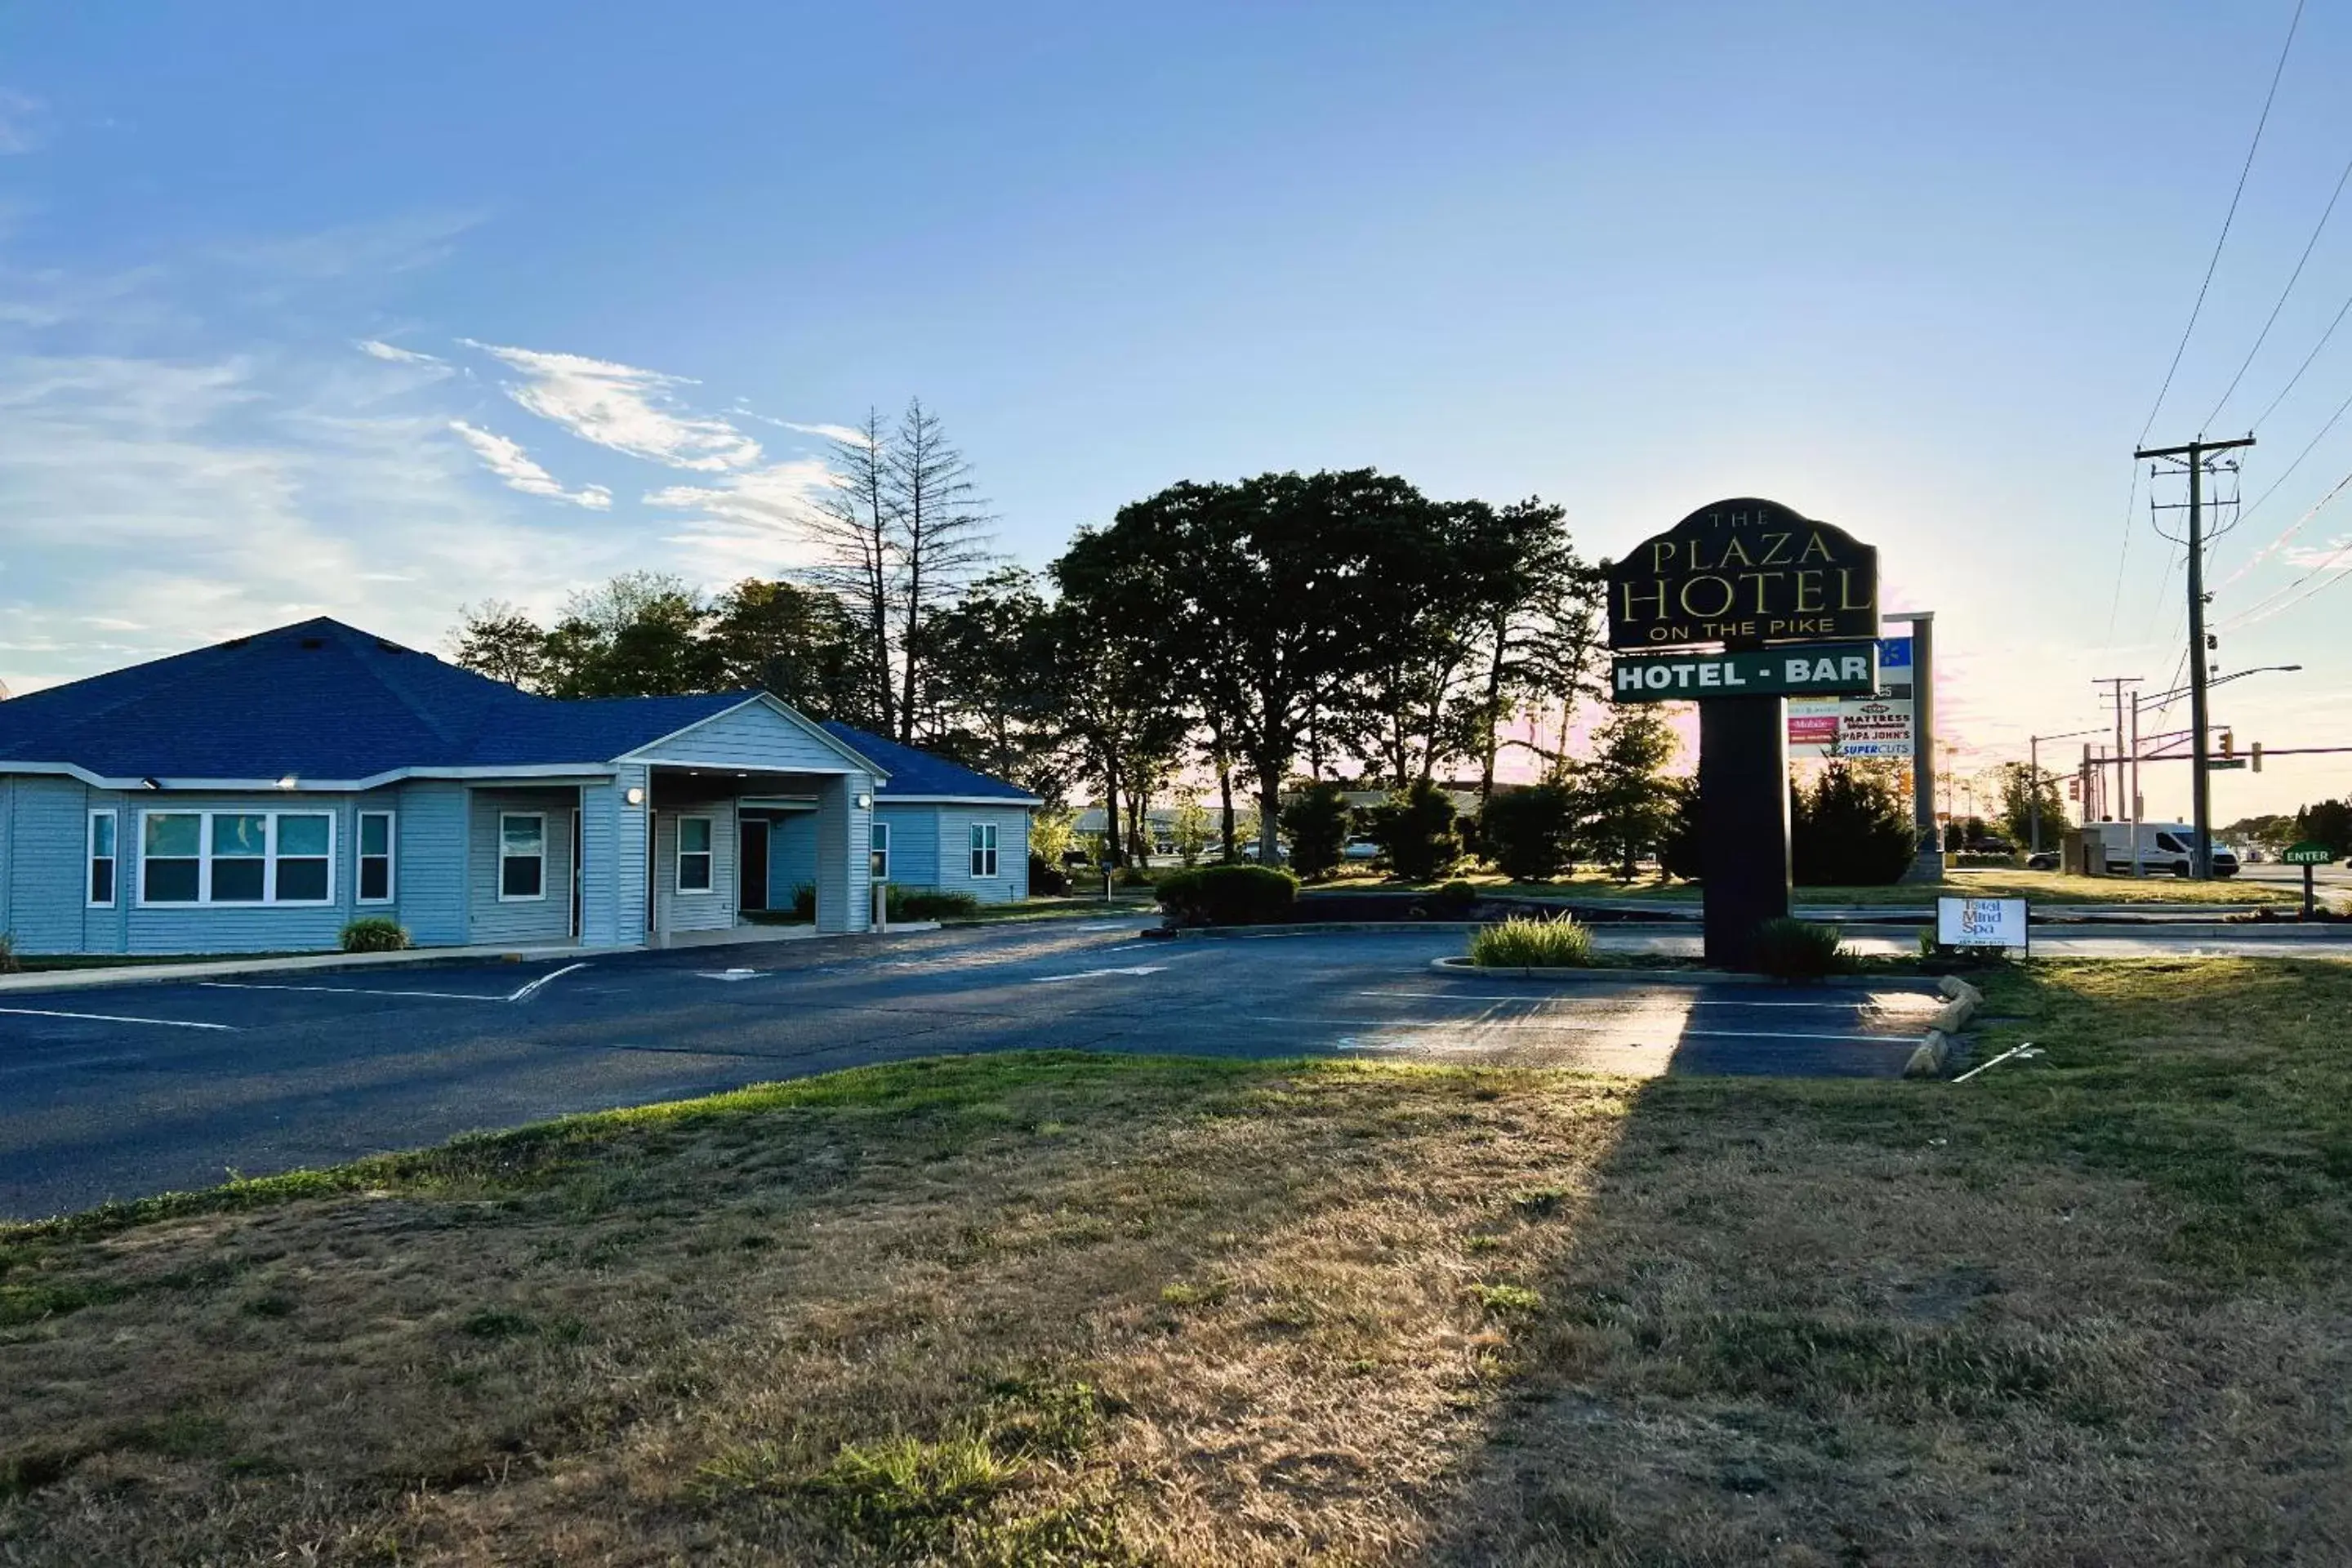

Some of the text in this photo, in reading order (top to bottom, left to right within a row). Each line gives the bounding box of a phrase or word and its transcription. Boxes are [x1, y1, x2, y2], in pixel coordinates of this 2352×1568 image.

[1708, 509, 1770, 528] THE
[1653, 531, 1835, 573] PLAZA
[1621, 568, 1873, 622] HOTEL
[1649, 617, 1835, 641] ON THE PIKE
[1617, 662, 1746, 691] HOTEL
[1785, 656, 1869, 684] BAR
[1843, 714, 1910, 724] MATTRESS
[1842, 732, 1869, 741] PAPA
[1872, 730, 1911, 740] JOHN'S
[1843, 744, 1909, 755] SUPERCUTS
[2287, 850, 2330, 862] ENTER
[1965, 899, 2000, 911] Total
[1962, 911, 2002, 923] Mind
[1962, 922, 1994, 935] Spa
